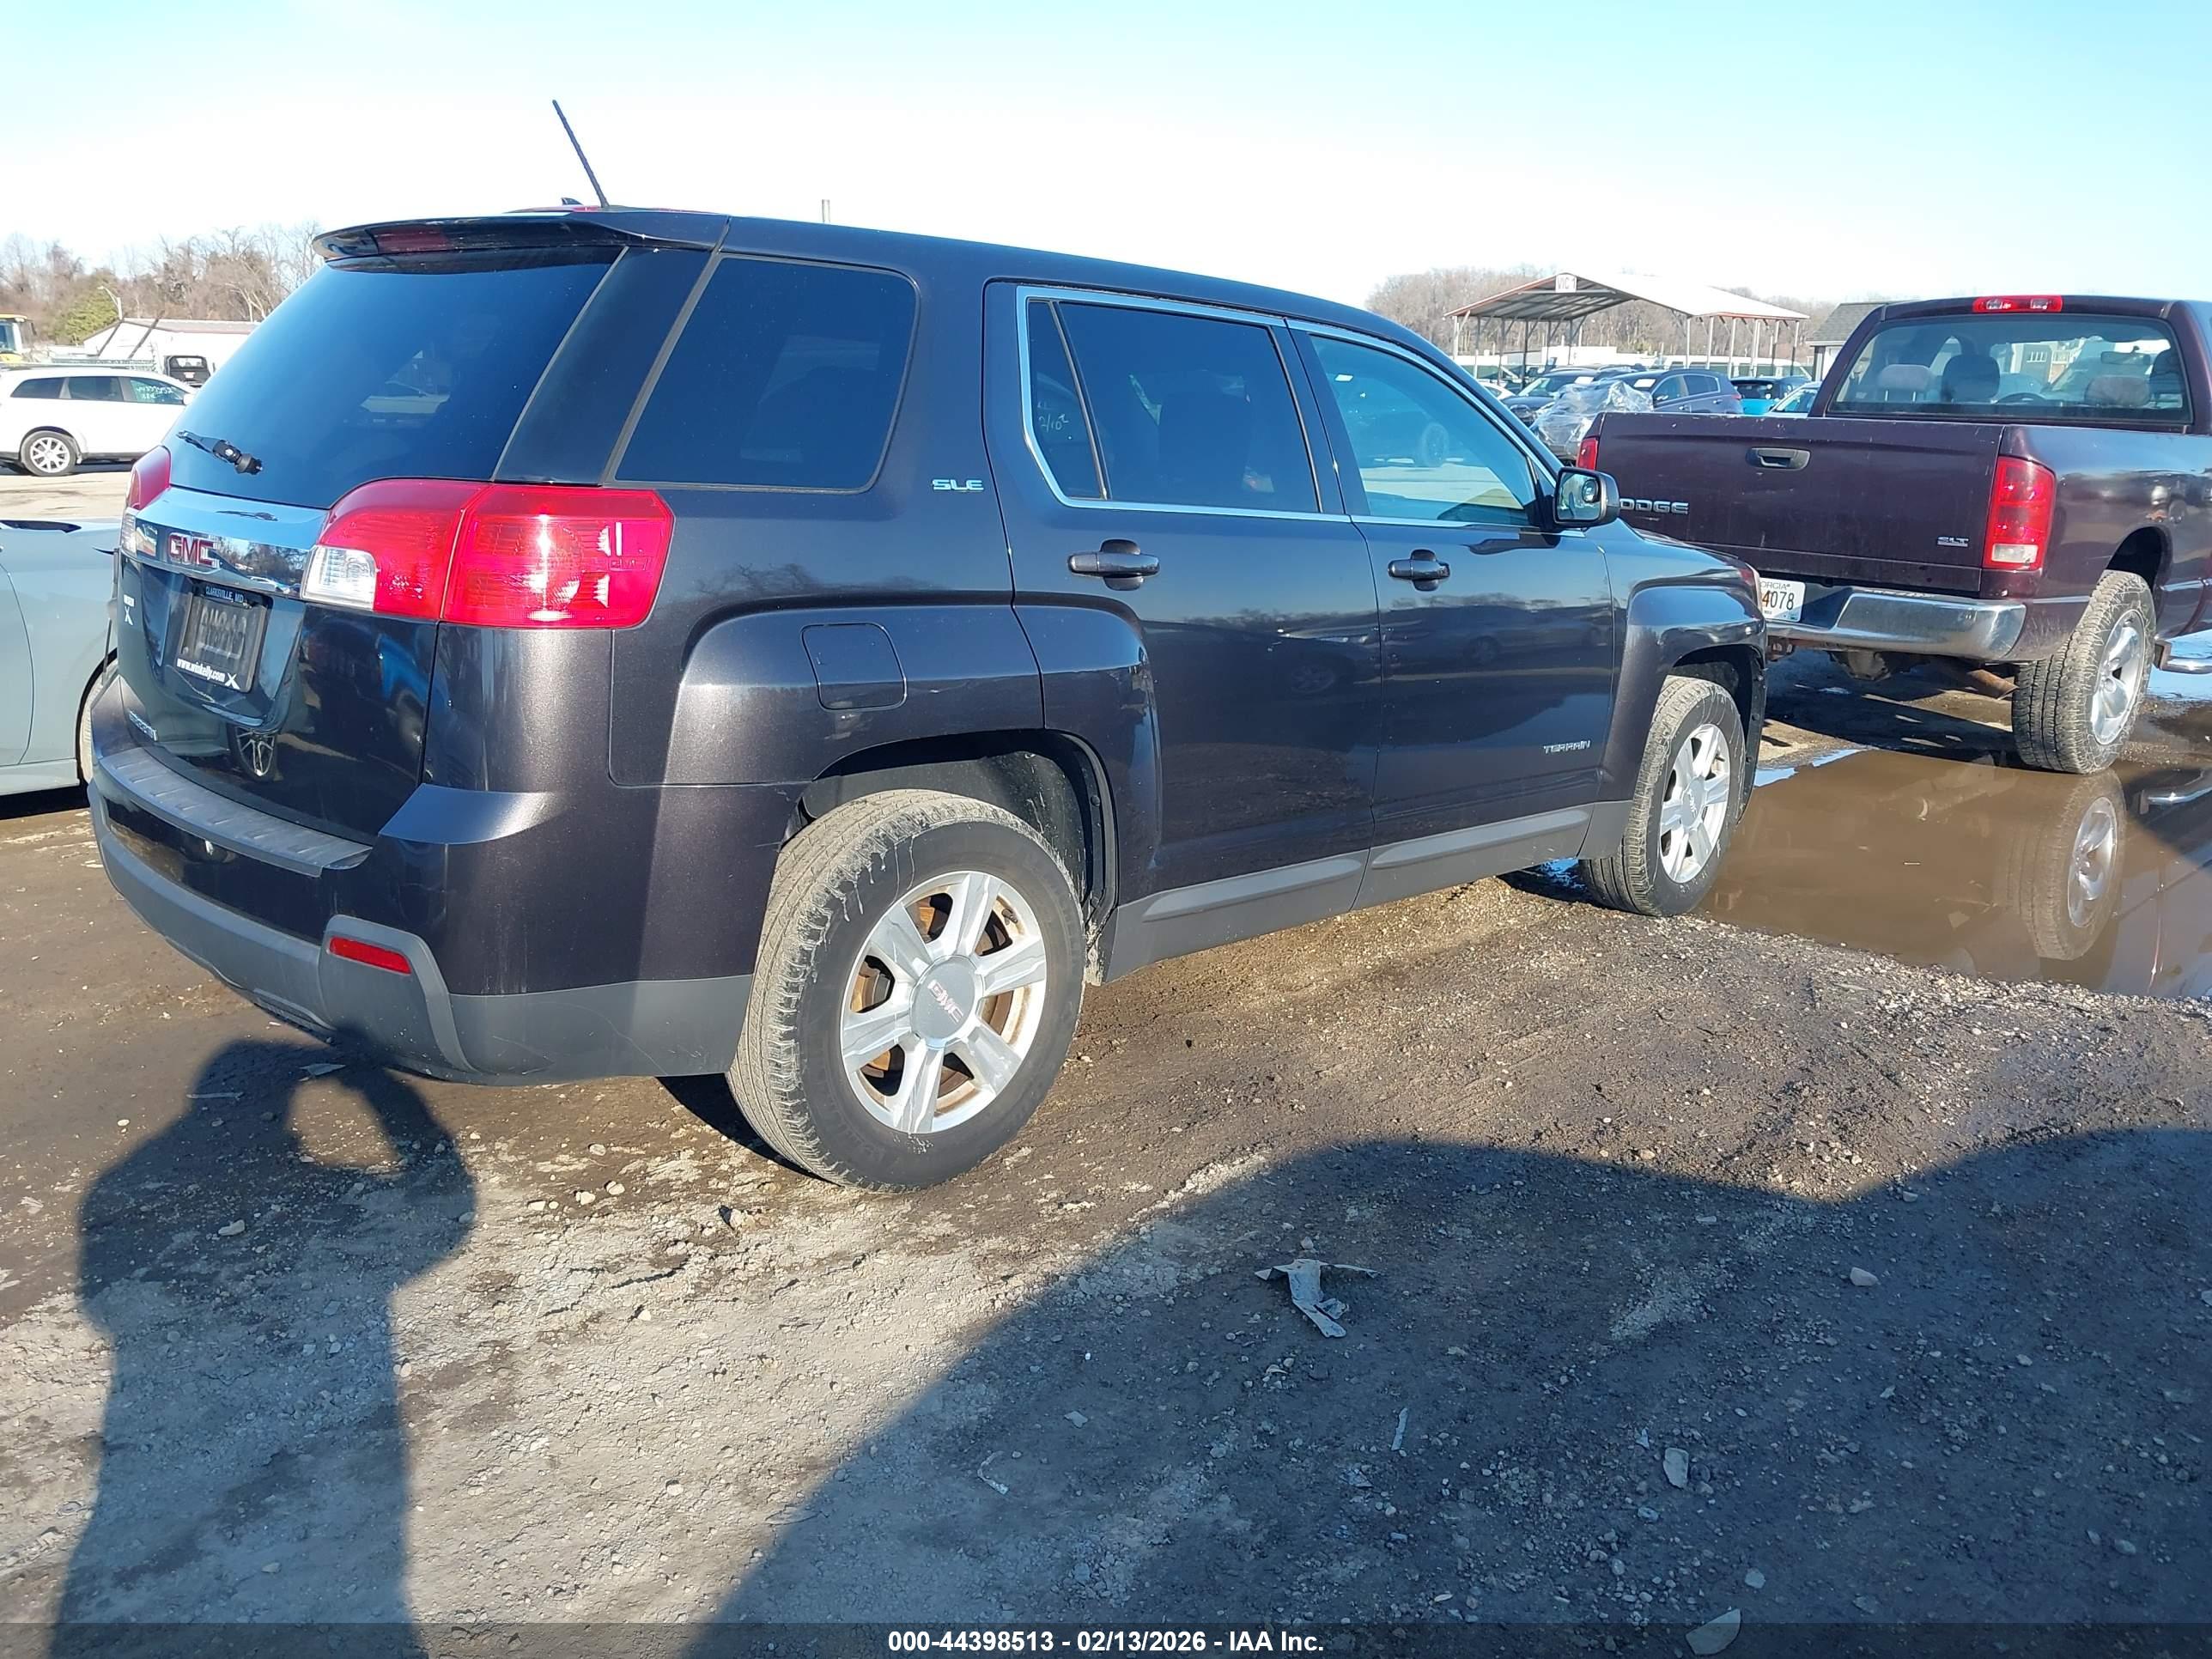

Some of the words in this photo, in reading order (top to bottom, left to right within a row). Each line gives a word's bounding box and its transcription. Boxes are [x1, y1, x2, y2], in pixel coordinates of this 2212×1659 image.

[932, 478, 985, 492] SLE
[168, 532, 220, 568] GMC
[1543, 739, 1591, 755] TERRAIN
[927, 979, 963, 1024] GMC
